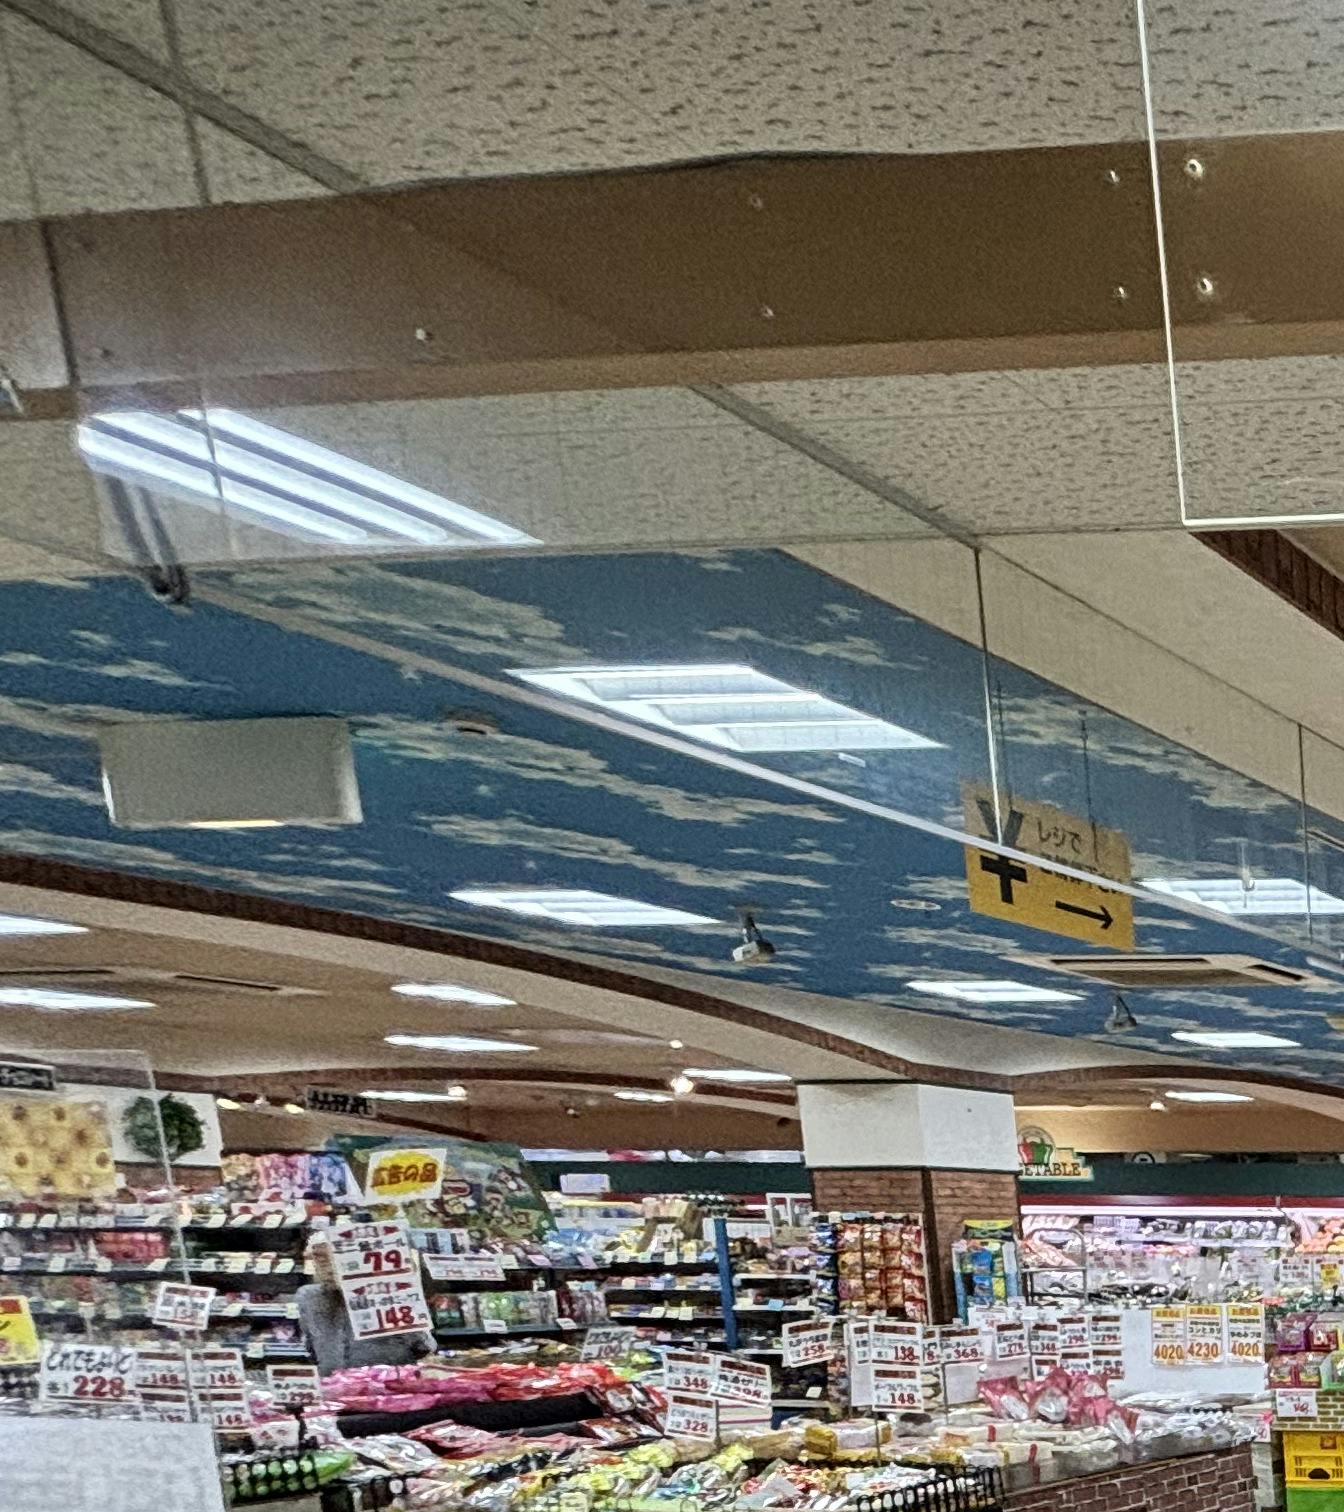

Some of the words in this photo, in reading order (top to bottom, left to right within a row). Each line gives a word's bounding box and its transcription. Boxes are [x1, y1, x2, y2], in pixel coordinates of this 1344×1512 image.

[1019, 1162, 1081, 1176] ETABLE
[363, 1250, 402, 1271] 79
[376, 1306, 415, 1330] 148
